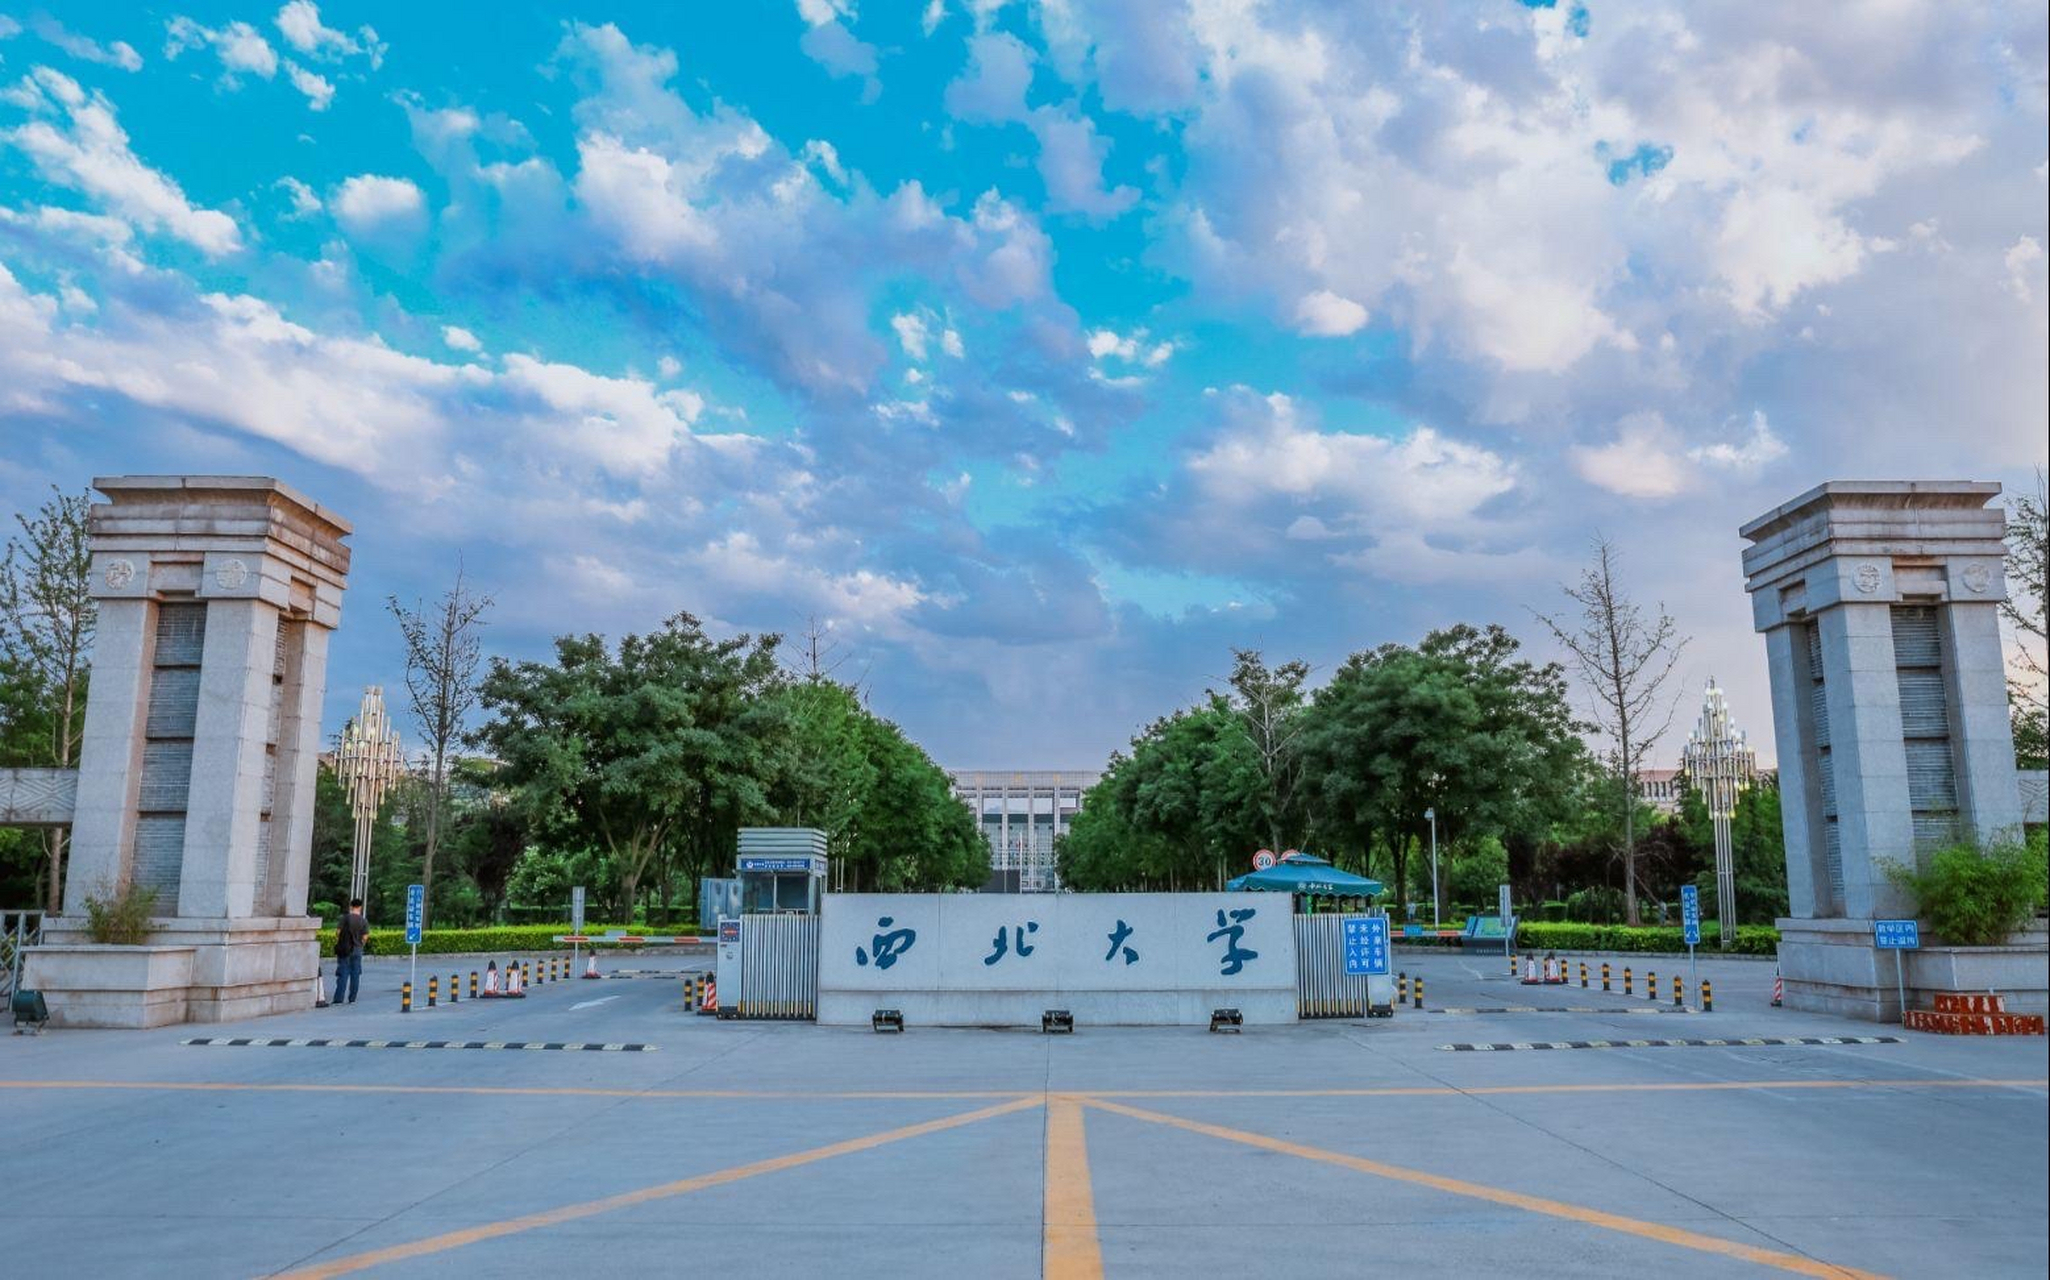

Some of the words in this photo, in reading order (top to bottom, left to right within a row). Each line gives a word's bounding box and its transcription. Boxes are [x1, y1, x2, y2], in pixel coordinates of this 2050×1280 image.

[1258, 856, 1271, 866] 30
[856, 908, 1259, 975] 西北大学
[1347, 924, 1357, 968] 禁止入内
[1360, 923, 1369, 968] 未经许可
